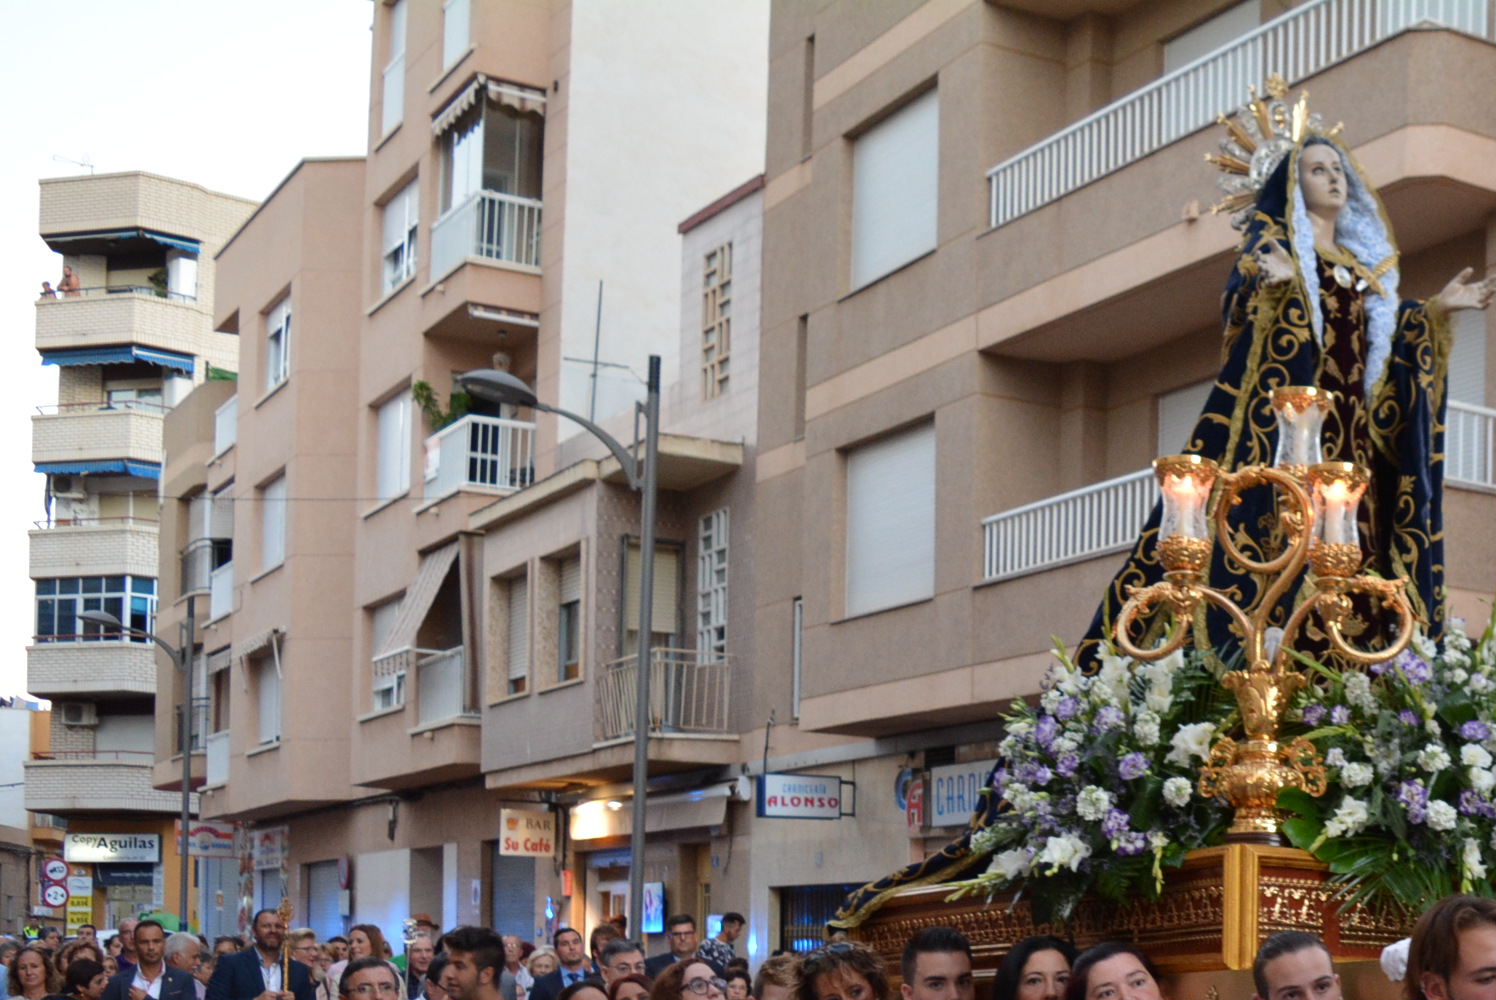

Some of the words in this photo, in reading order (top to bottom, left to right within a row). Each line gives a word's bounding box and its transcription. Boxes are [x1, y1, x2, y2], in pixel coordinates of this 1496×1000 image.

[767, 795, 839, 809] ALONSO
[526, 817, 552, 830] BAR
[504, 837, 519, 851] Su
[524, 837, 551, 853] Café
[53, 890, 59, 900] 2
